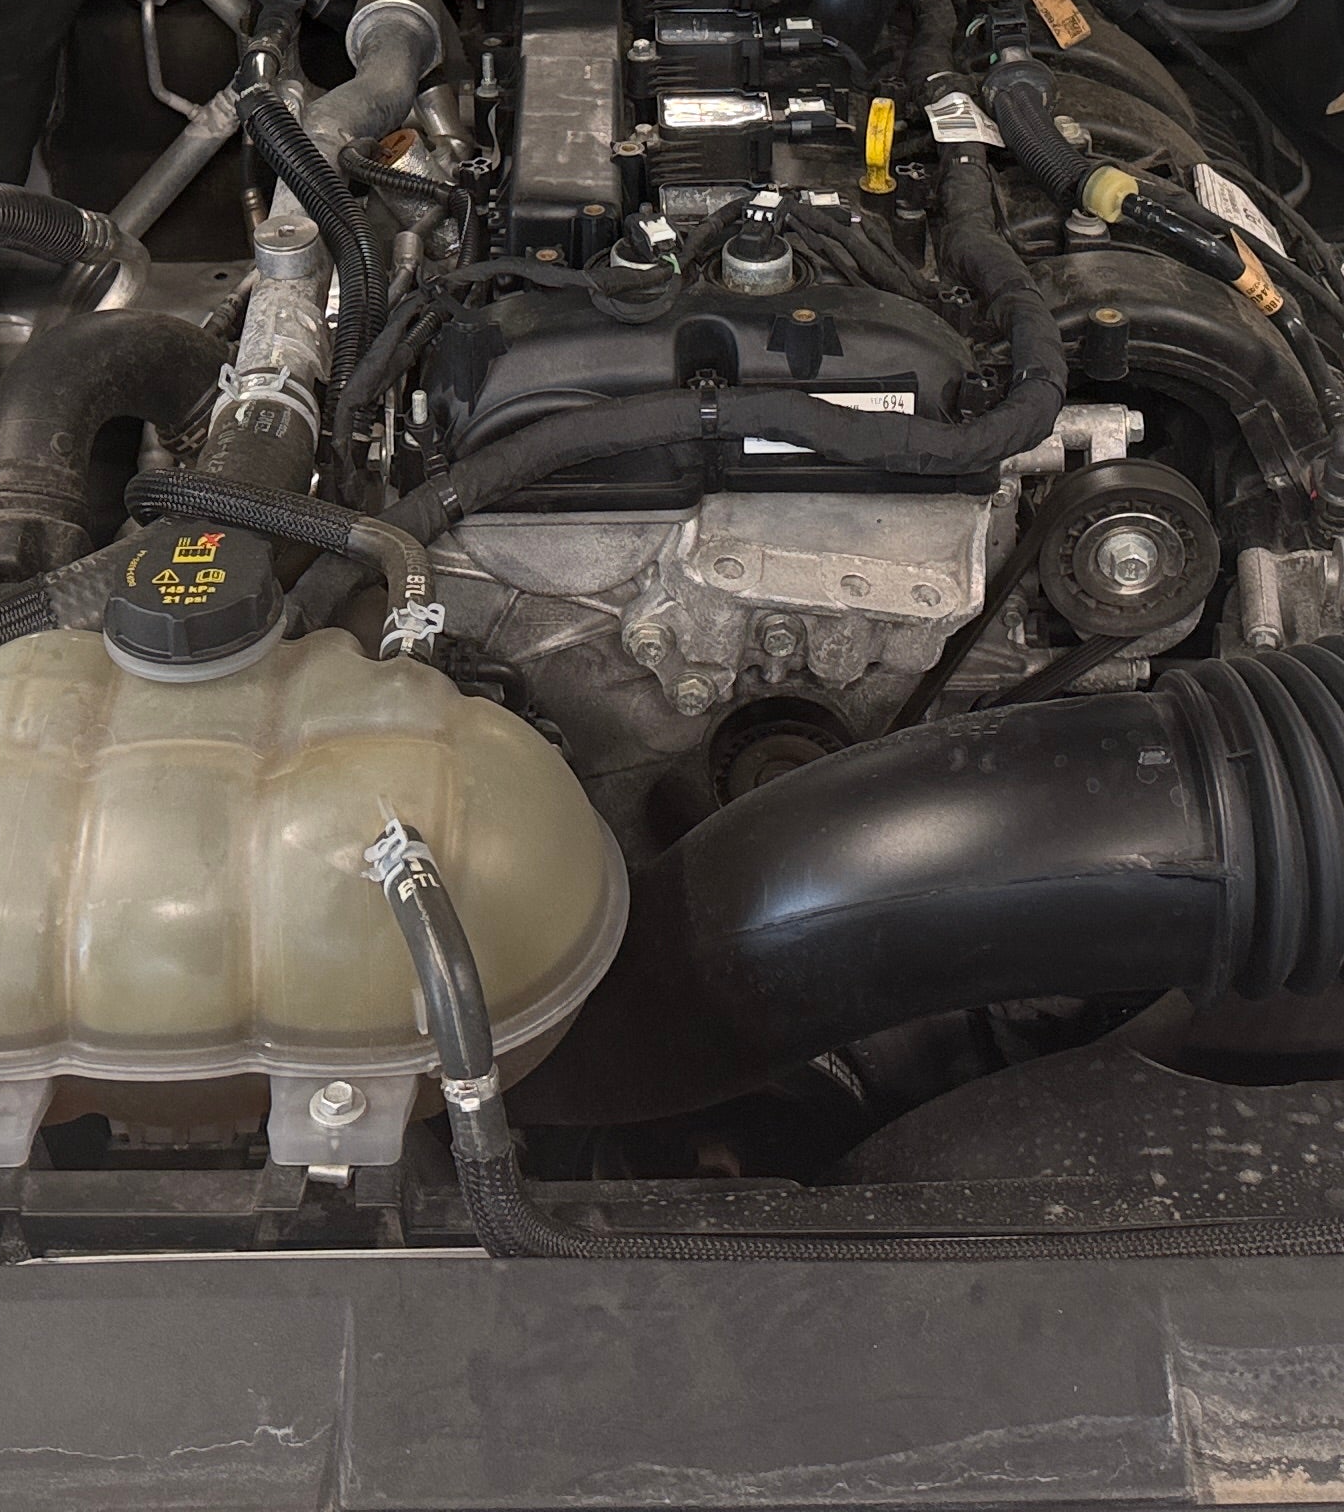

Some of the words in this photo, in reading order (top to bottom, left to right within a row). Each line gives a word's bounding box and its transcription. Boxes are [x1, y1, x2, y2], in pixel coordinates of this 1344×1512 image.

[158, 585, 186, 594] 145
[188, 585, 216, 594] kPa
[405, 574, 425, 599] BTL
[162, 595, 181, 604] 21
[184, 594, 208, 605] psi
